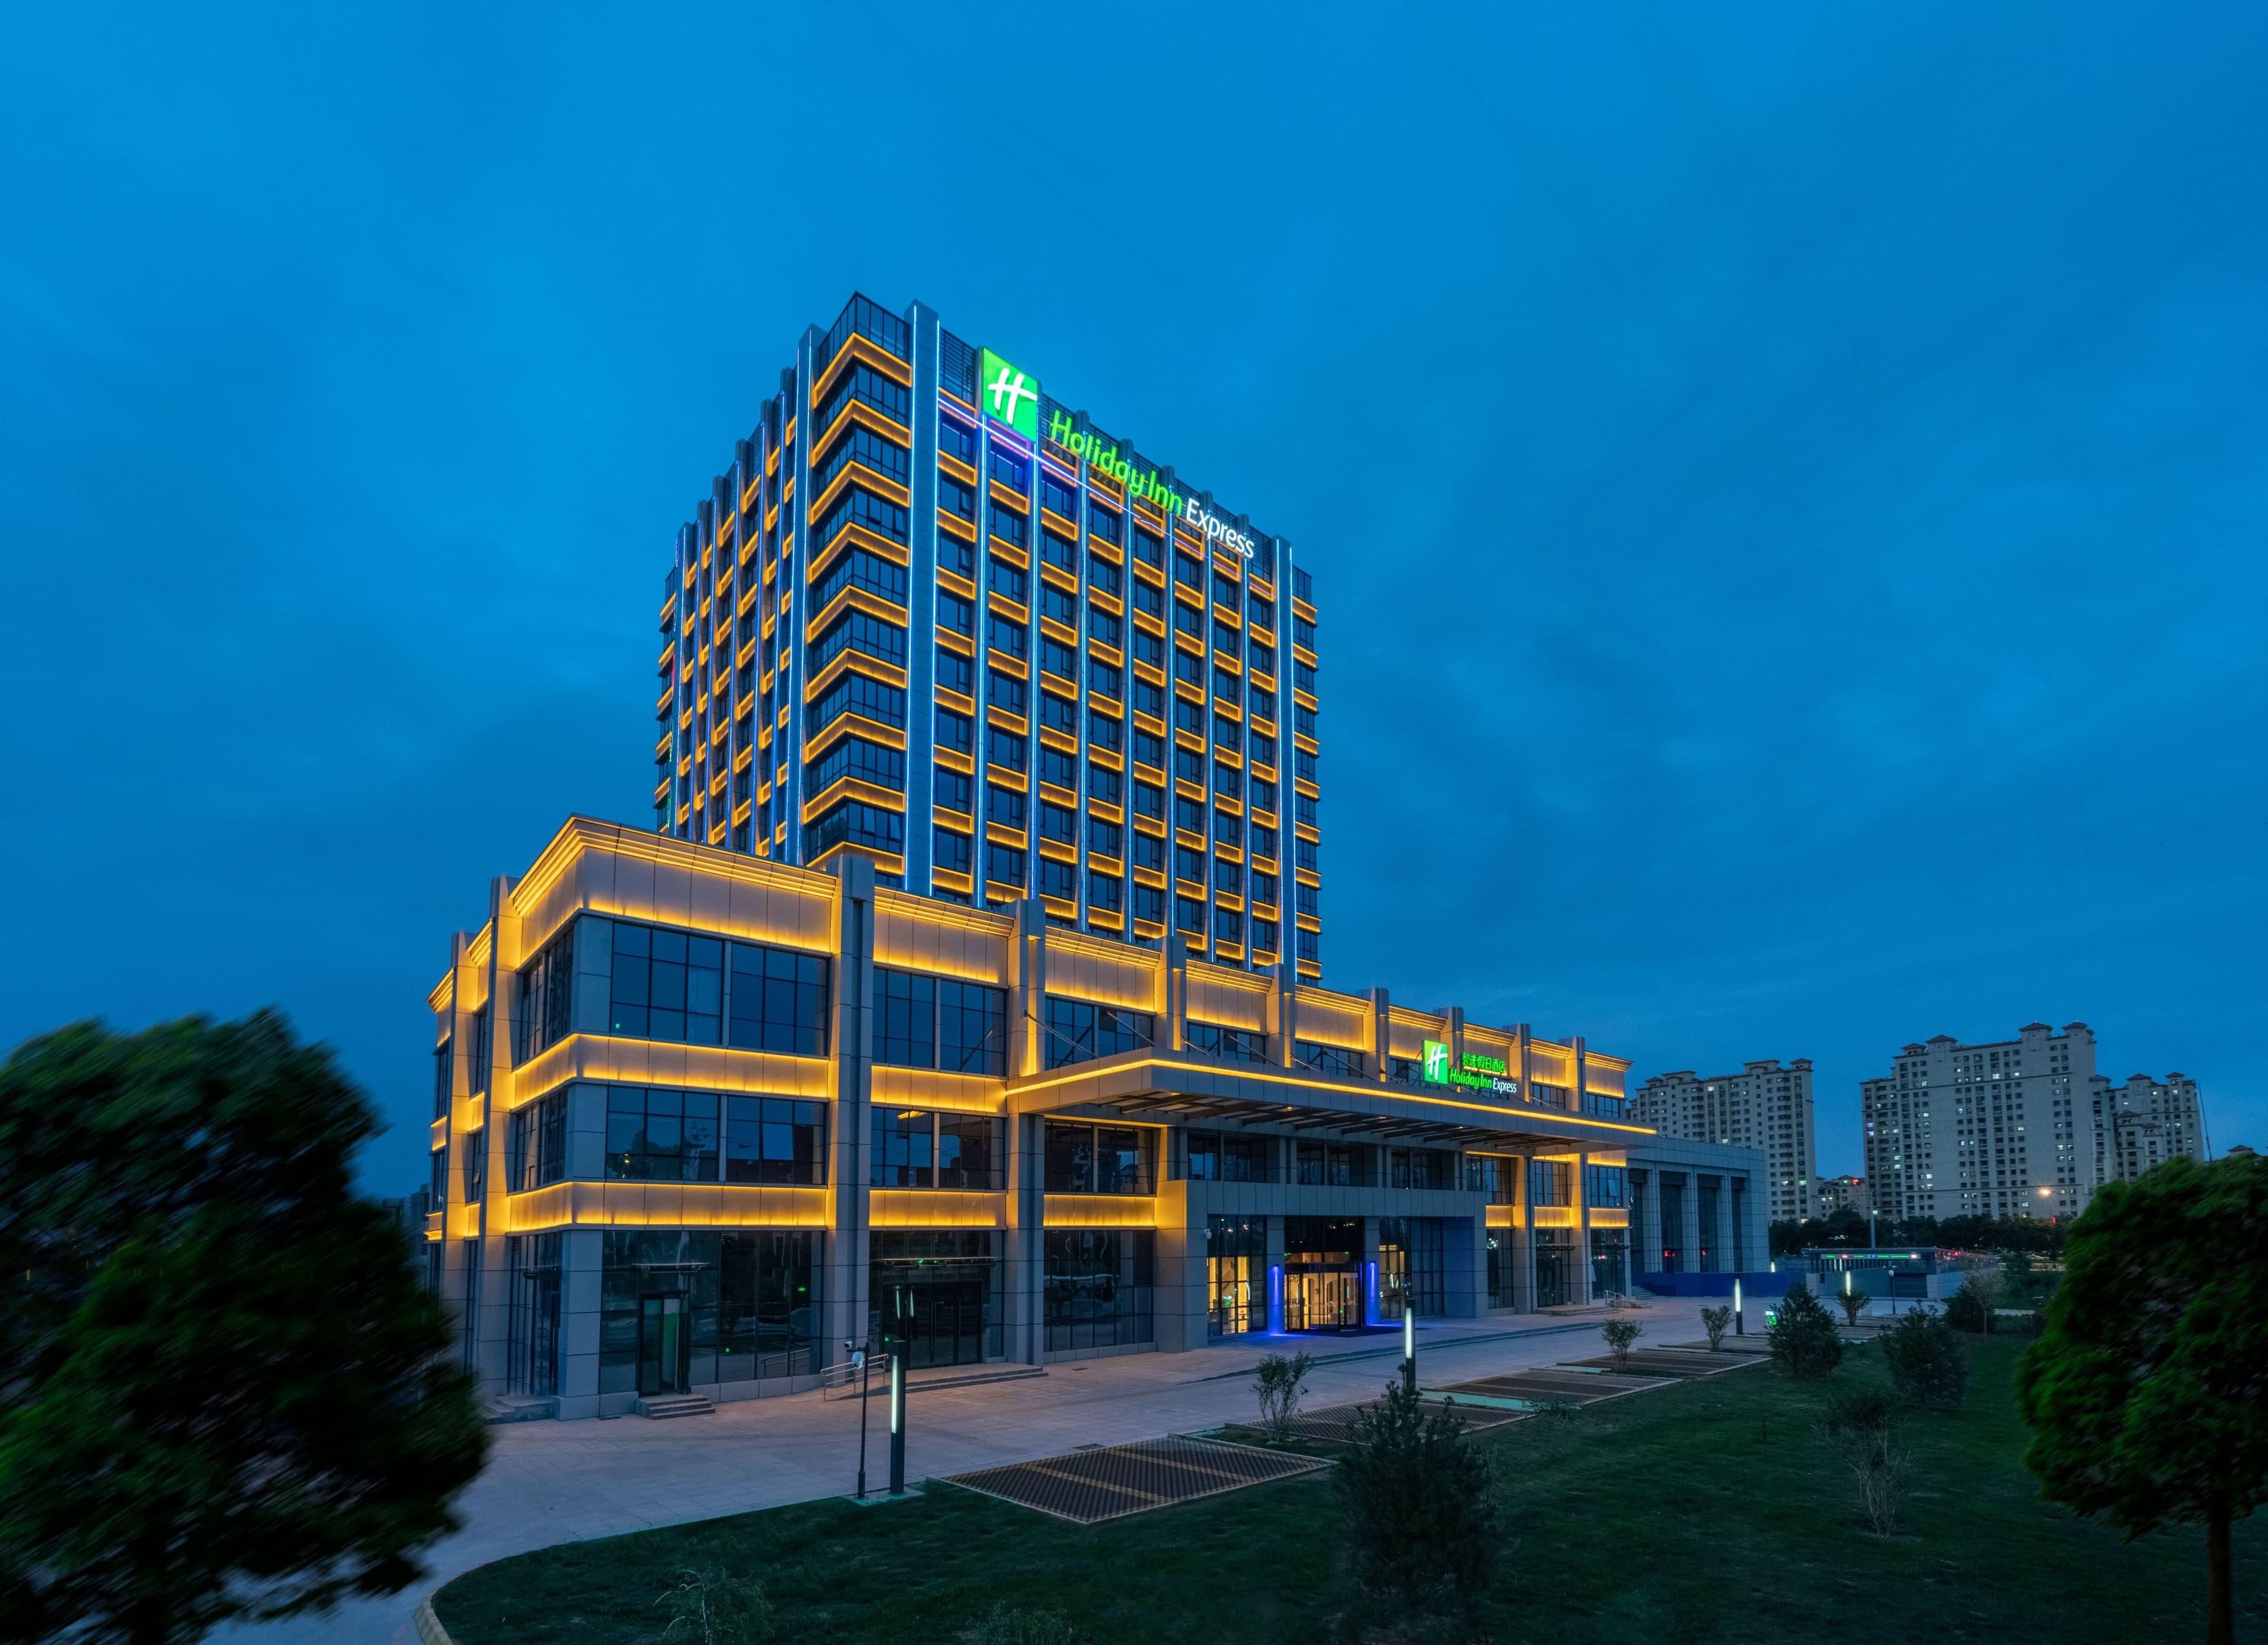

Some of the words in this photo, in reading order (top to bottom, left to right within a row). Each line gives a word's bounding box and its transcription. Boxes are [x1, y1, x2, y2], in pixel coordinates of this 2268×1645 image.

[1186, 498, 1254, 559] Express
[1462, 1052, 1506, 1073] 智选假日酒店
[1493, 1078, 1517, 1094] Express
